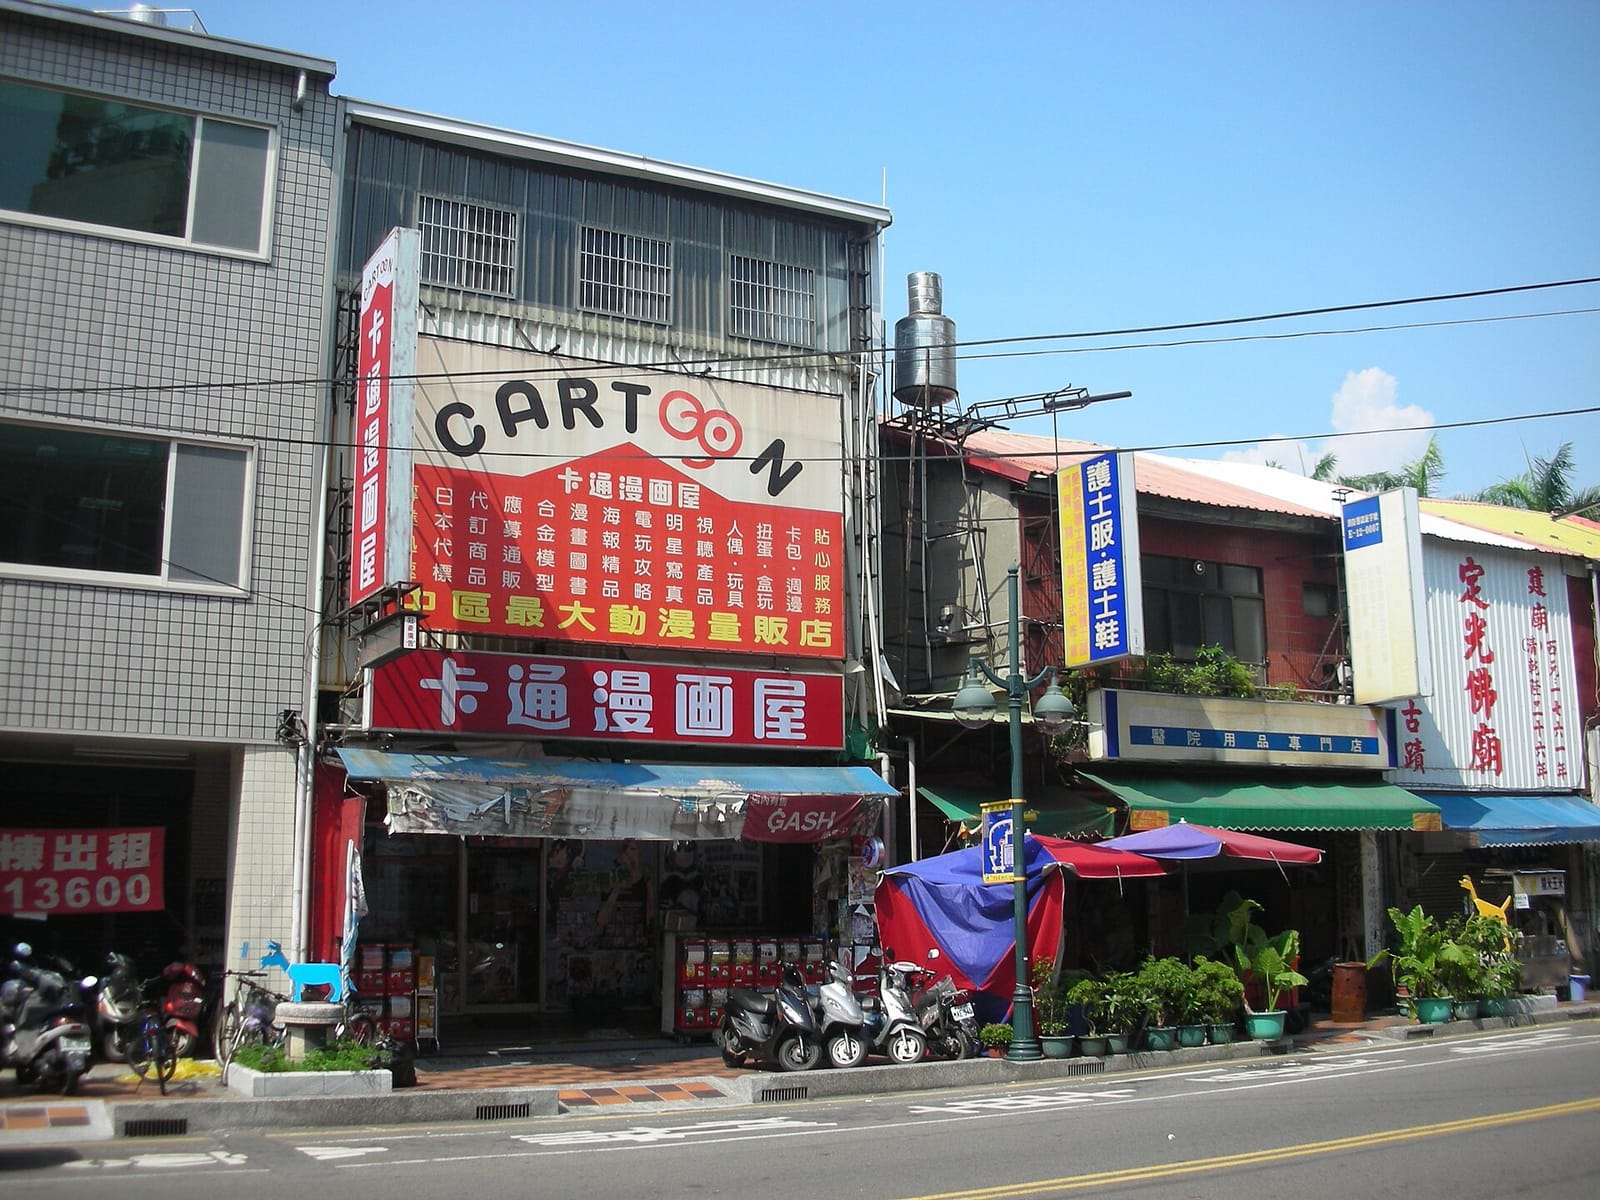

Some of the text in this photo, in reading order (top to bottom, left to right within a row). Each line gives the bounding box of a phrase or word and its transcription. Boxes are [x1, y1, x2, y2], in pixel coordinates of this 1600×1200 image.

[557, 466, 700, 510] 卡通漫画屋
[432, 486, 454, 583] 日本代標
[468, 490, 489, 586] 代訂商品
[502, 494, 523, 590] 應募通販
[536, 498, 556, 593] 合金模型
[569, 503, 588, 596] 漫畫圖書
[602, 506, 621, 598] 海報精品
[634, 510, 653, 601] 電玩攻略
[665, 513, 684, 604] 明星寫真
[696, 516, 714, 606] 視聽產品
[814, 527, 831, 615] 貼心服務
[1527, 565, 1549, 634] 建廟
[419, 656, 808, 742] 卡通漫画屋
[1458, 556, 1503, 777] 定光佛廟
[1151, 728, 1363, 754] 醫院用品專門店
[1401, 699, 1426, 774] 古蹟
[767, 808, 837, 833] GASH
[4, 873, 151, 909] 13600
